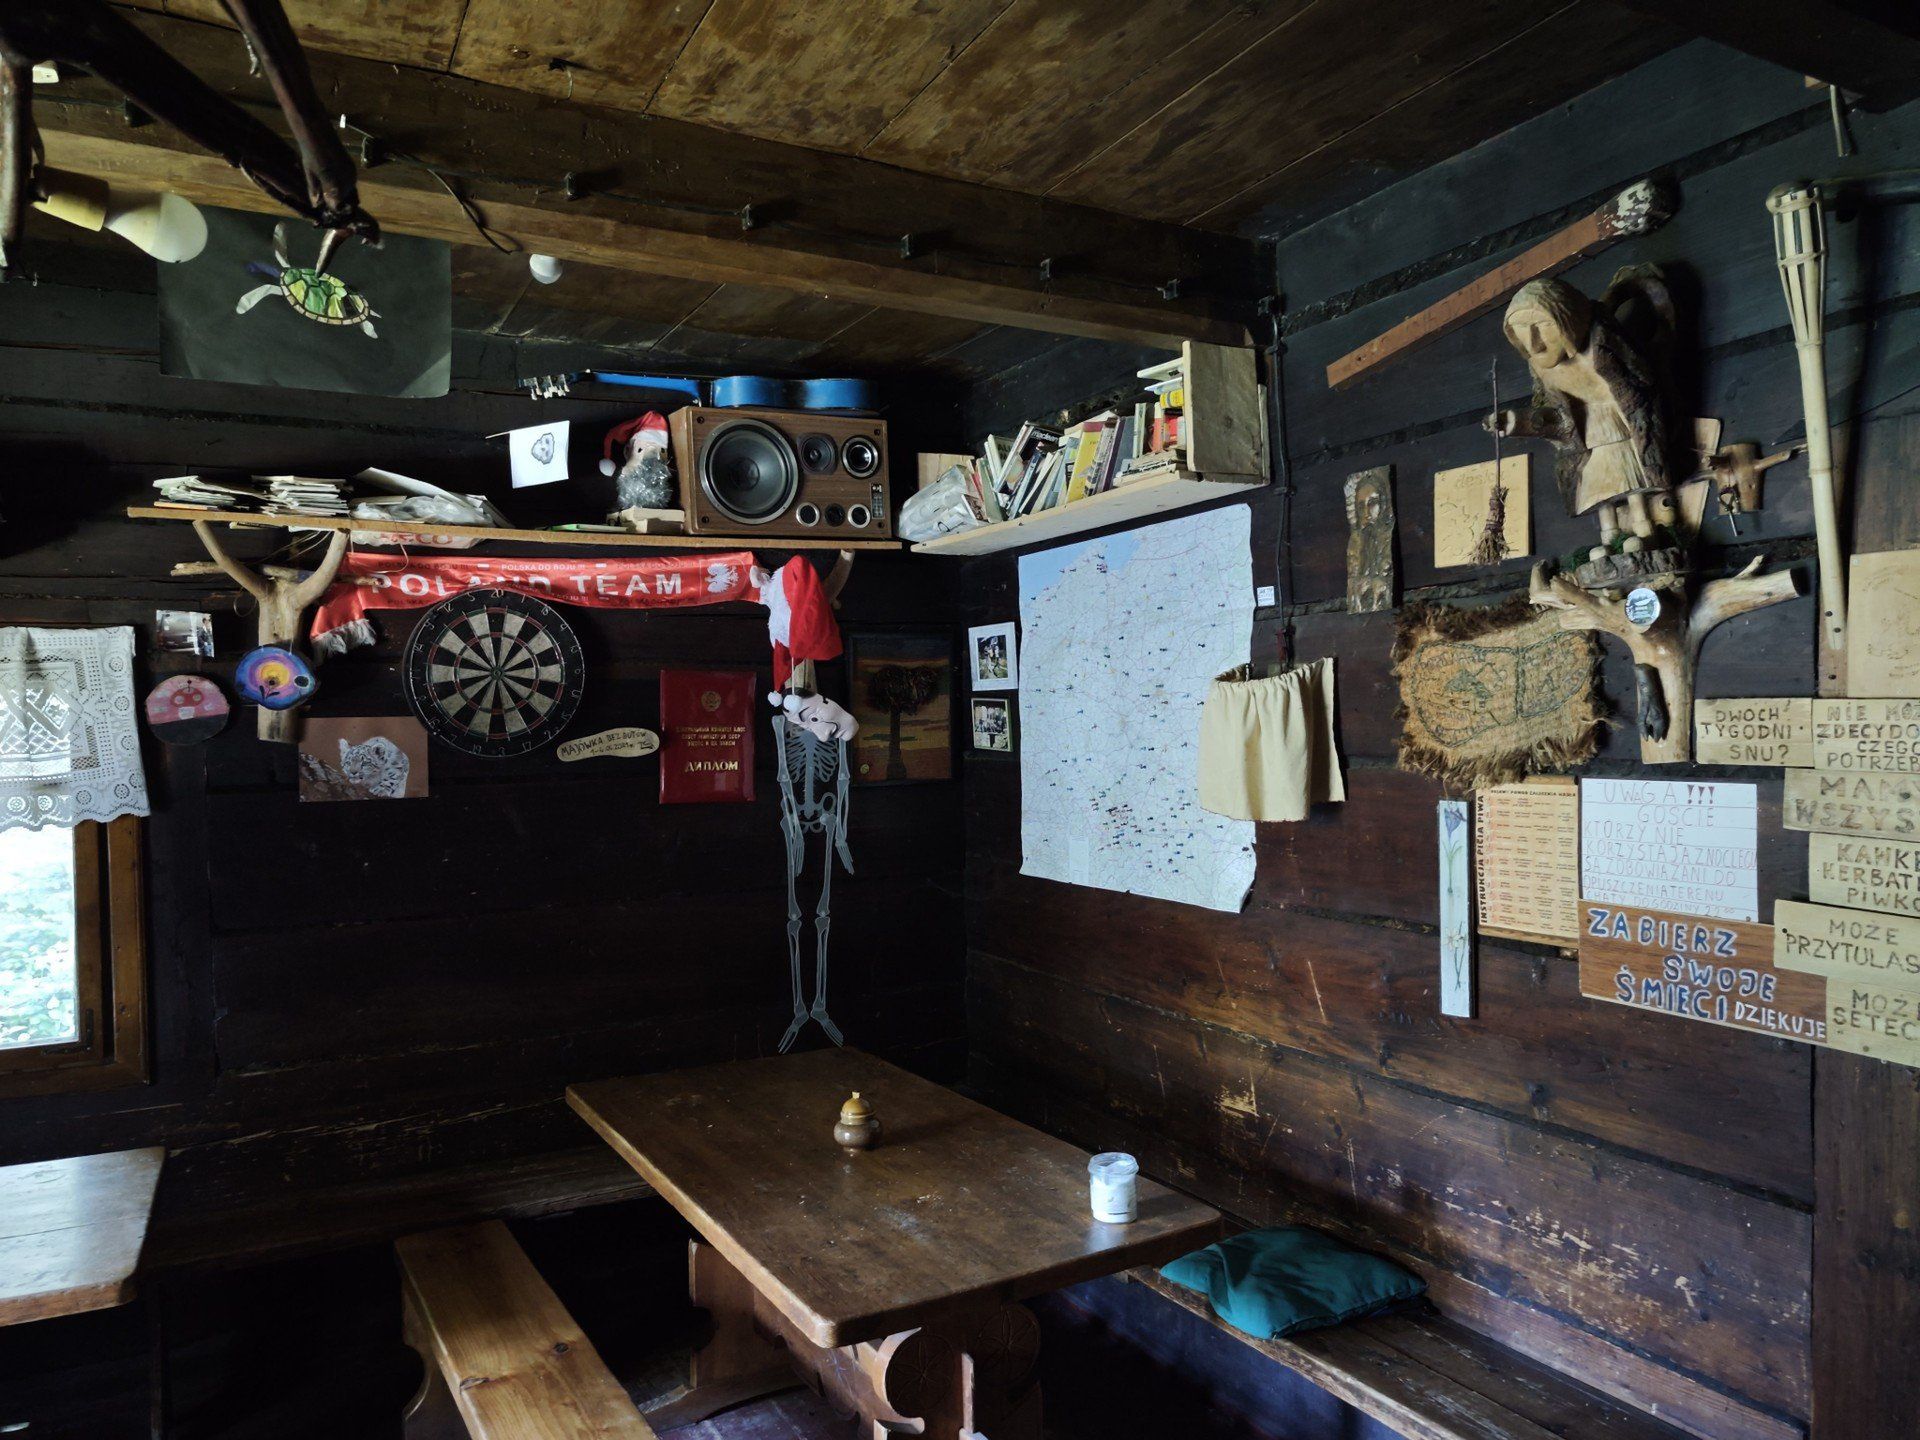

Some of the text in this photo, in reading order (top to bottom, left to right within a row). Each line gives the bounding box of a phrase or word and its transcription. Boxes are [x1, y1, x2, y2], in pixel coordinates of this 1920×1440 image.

[501, 563, 537, 571] POLSKA
[538, 563, 551, 571] DO
[371, 573, 682, 597] POLAD TEAM
[490, 588, 505, 599] 20
[1701, 721, 1792, 740] TYGODNI
[1816, 723, 1920, 740] ZDECYDO
[1729, 744, 1789, 765] SNU?
[1827, 752, 1920, 772] POTRZEB
[685, 761, 739, 773] ДИПЛОМ
[1476, 794, 1484, 823] PIWA
[1793, 799, 1920, 834] WSZYS
[1655, 826, 1685, 846] NIE
[1714, 868, 1737, 887] DO
[1477, 858, 1488, 924] INSTRUKCJA
[1586, 907, 1739, 958] ZABIERZ
[1663, 953, 1777, 1002] SWOJE
